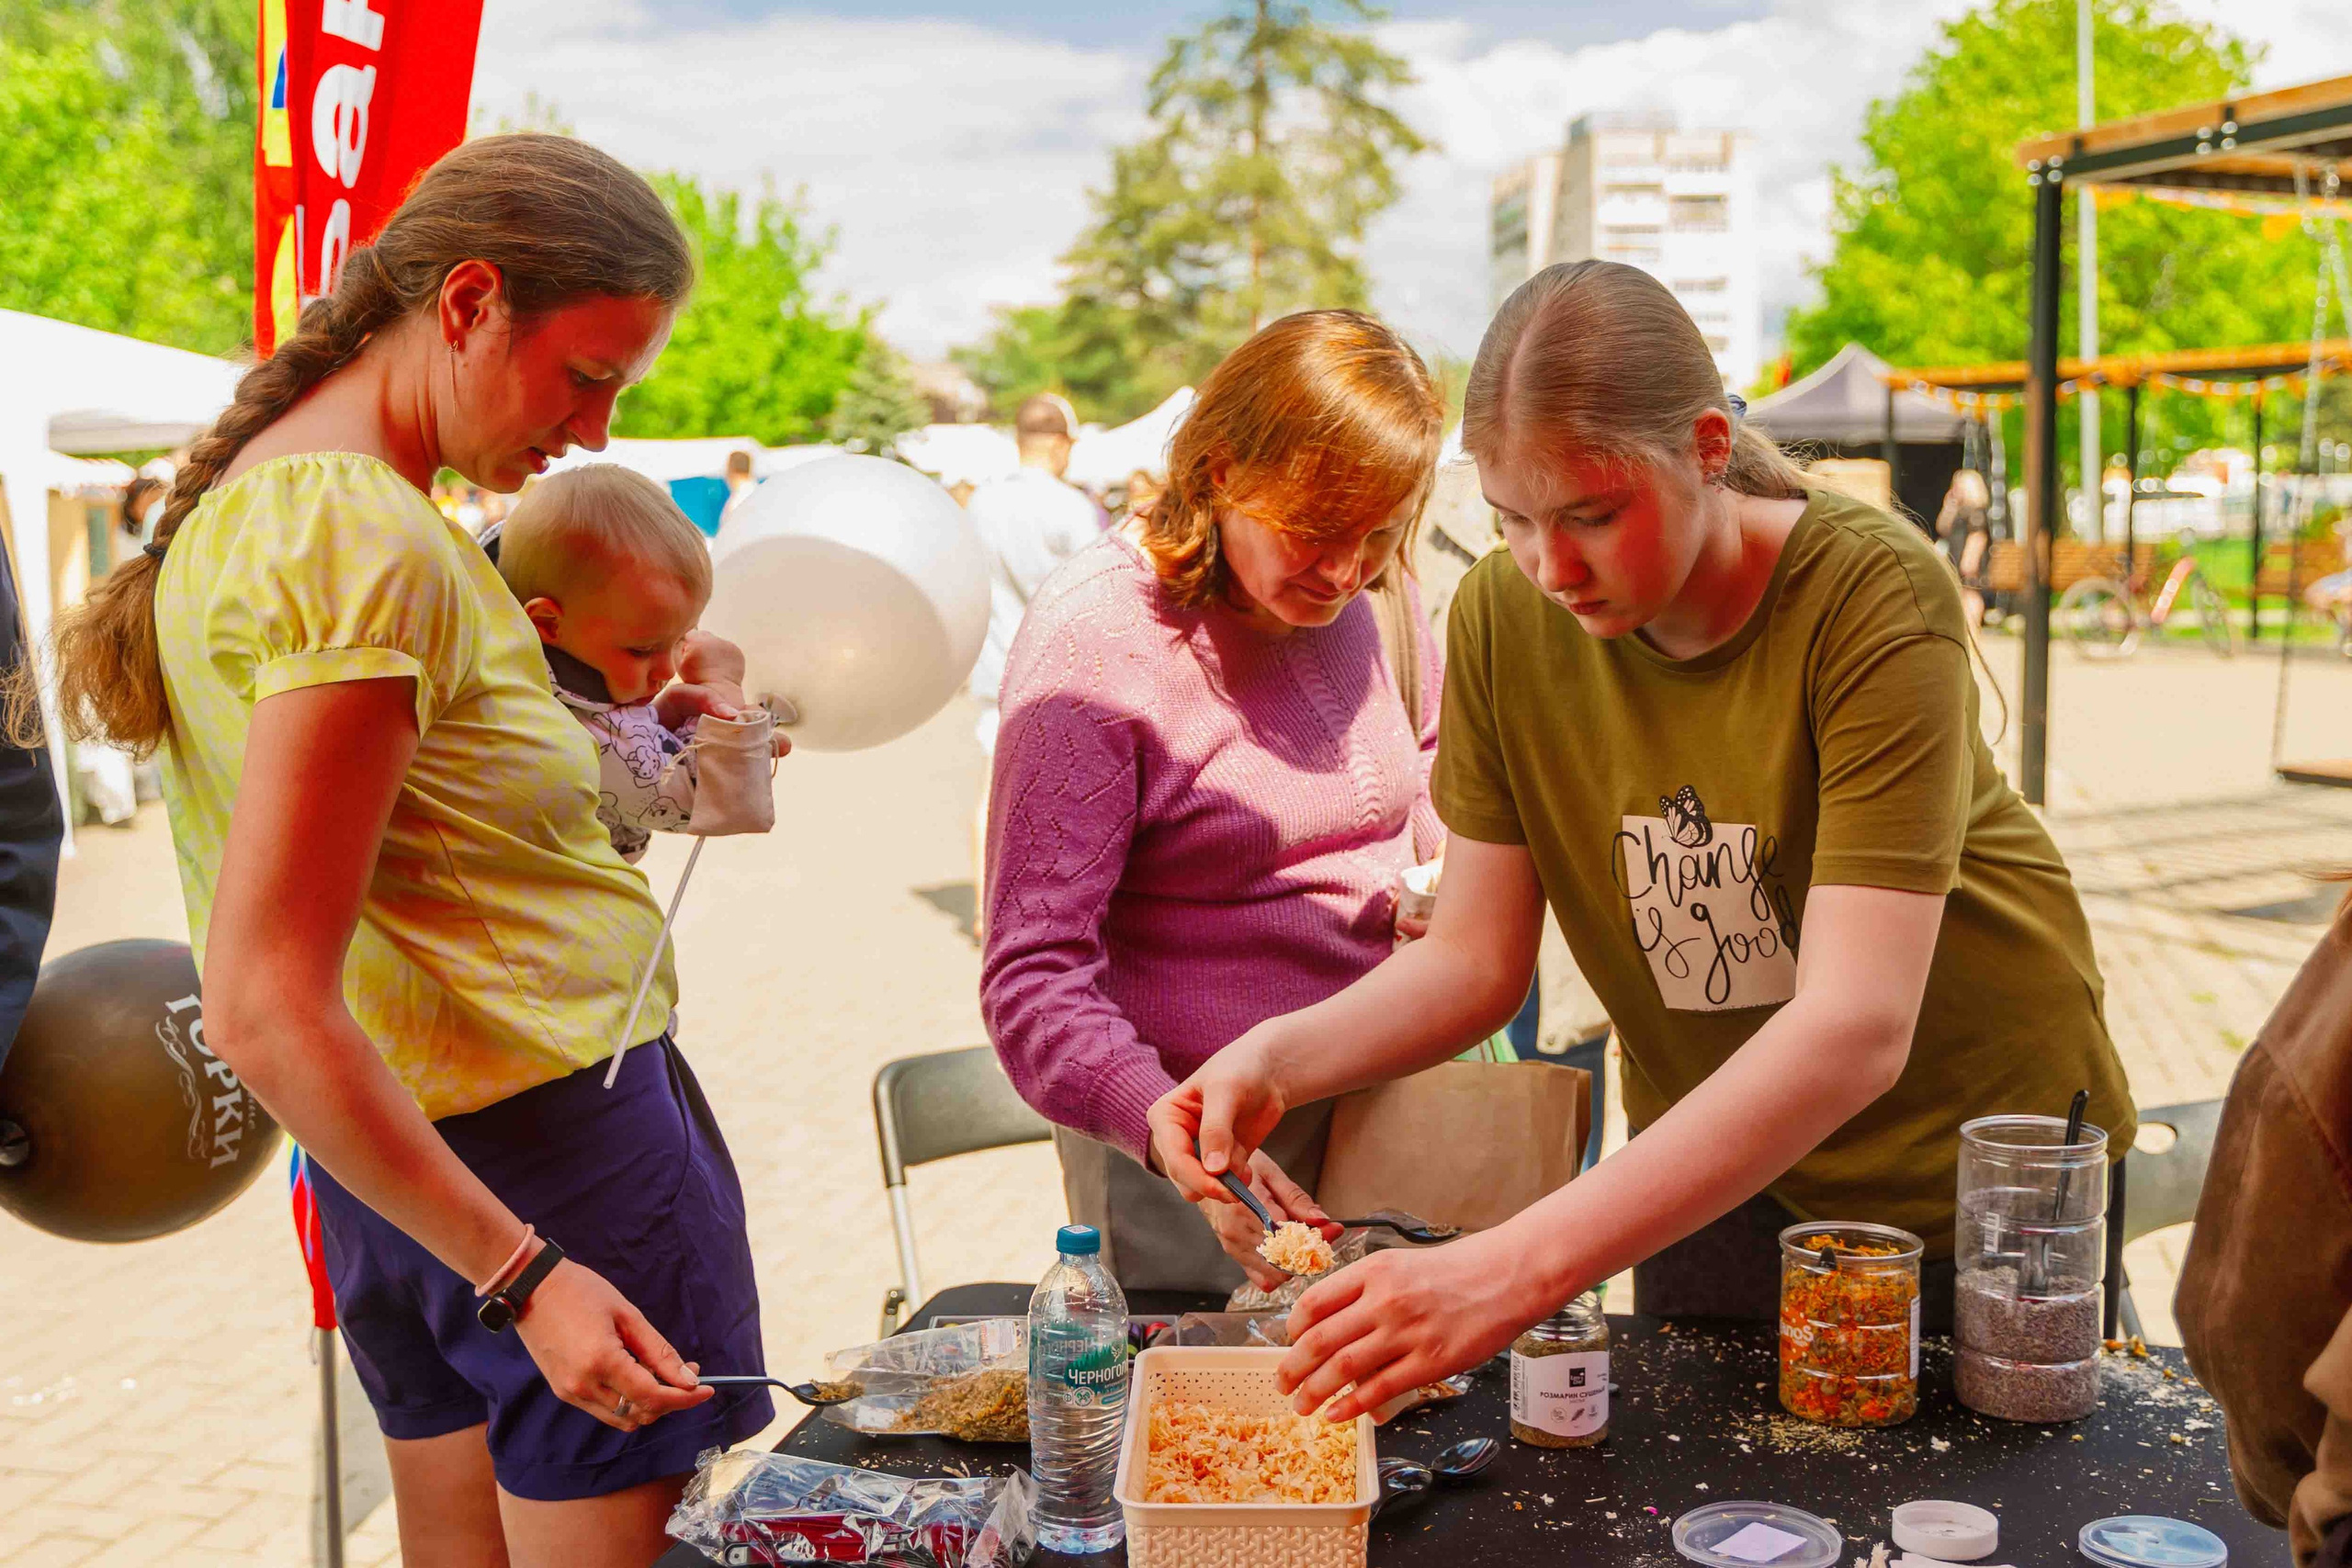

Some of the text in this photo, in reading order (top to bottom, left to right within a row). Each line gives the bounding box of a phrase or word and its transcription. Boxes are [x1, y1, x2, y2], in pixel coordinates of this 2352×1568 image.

[1612, 825, 1783, 921] Change
[1633, 885, 1801, 1004] is good
